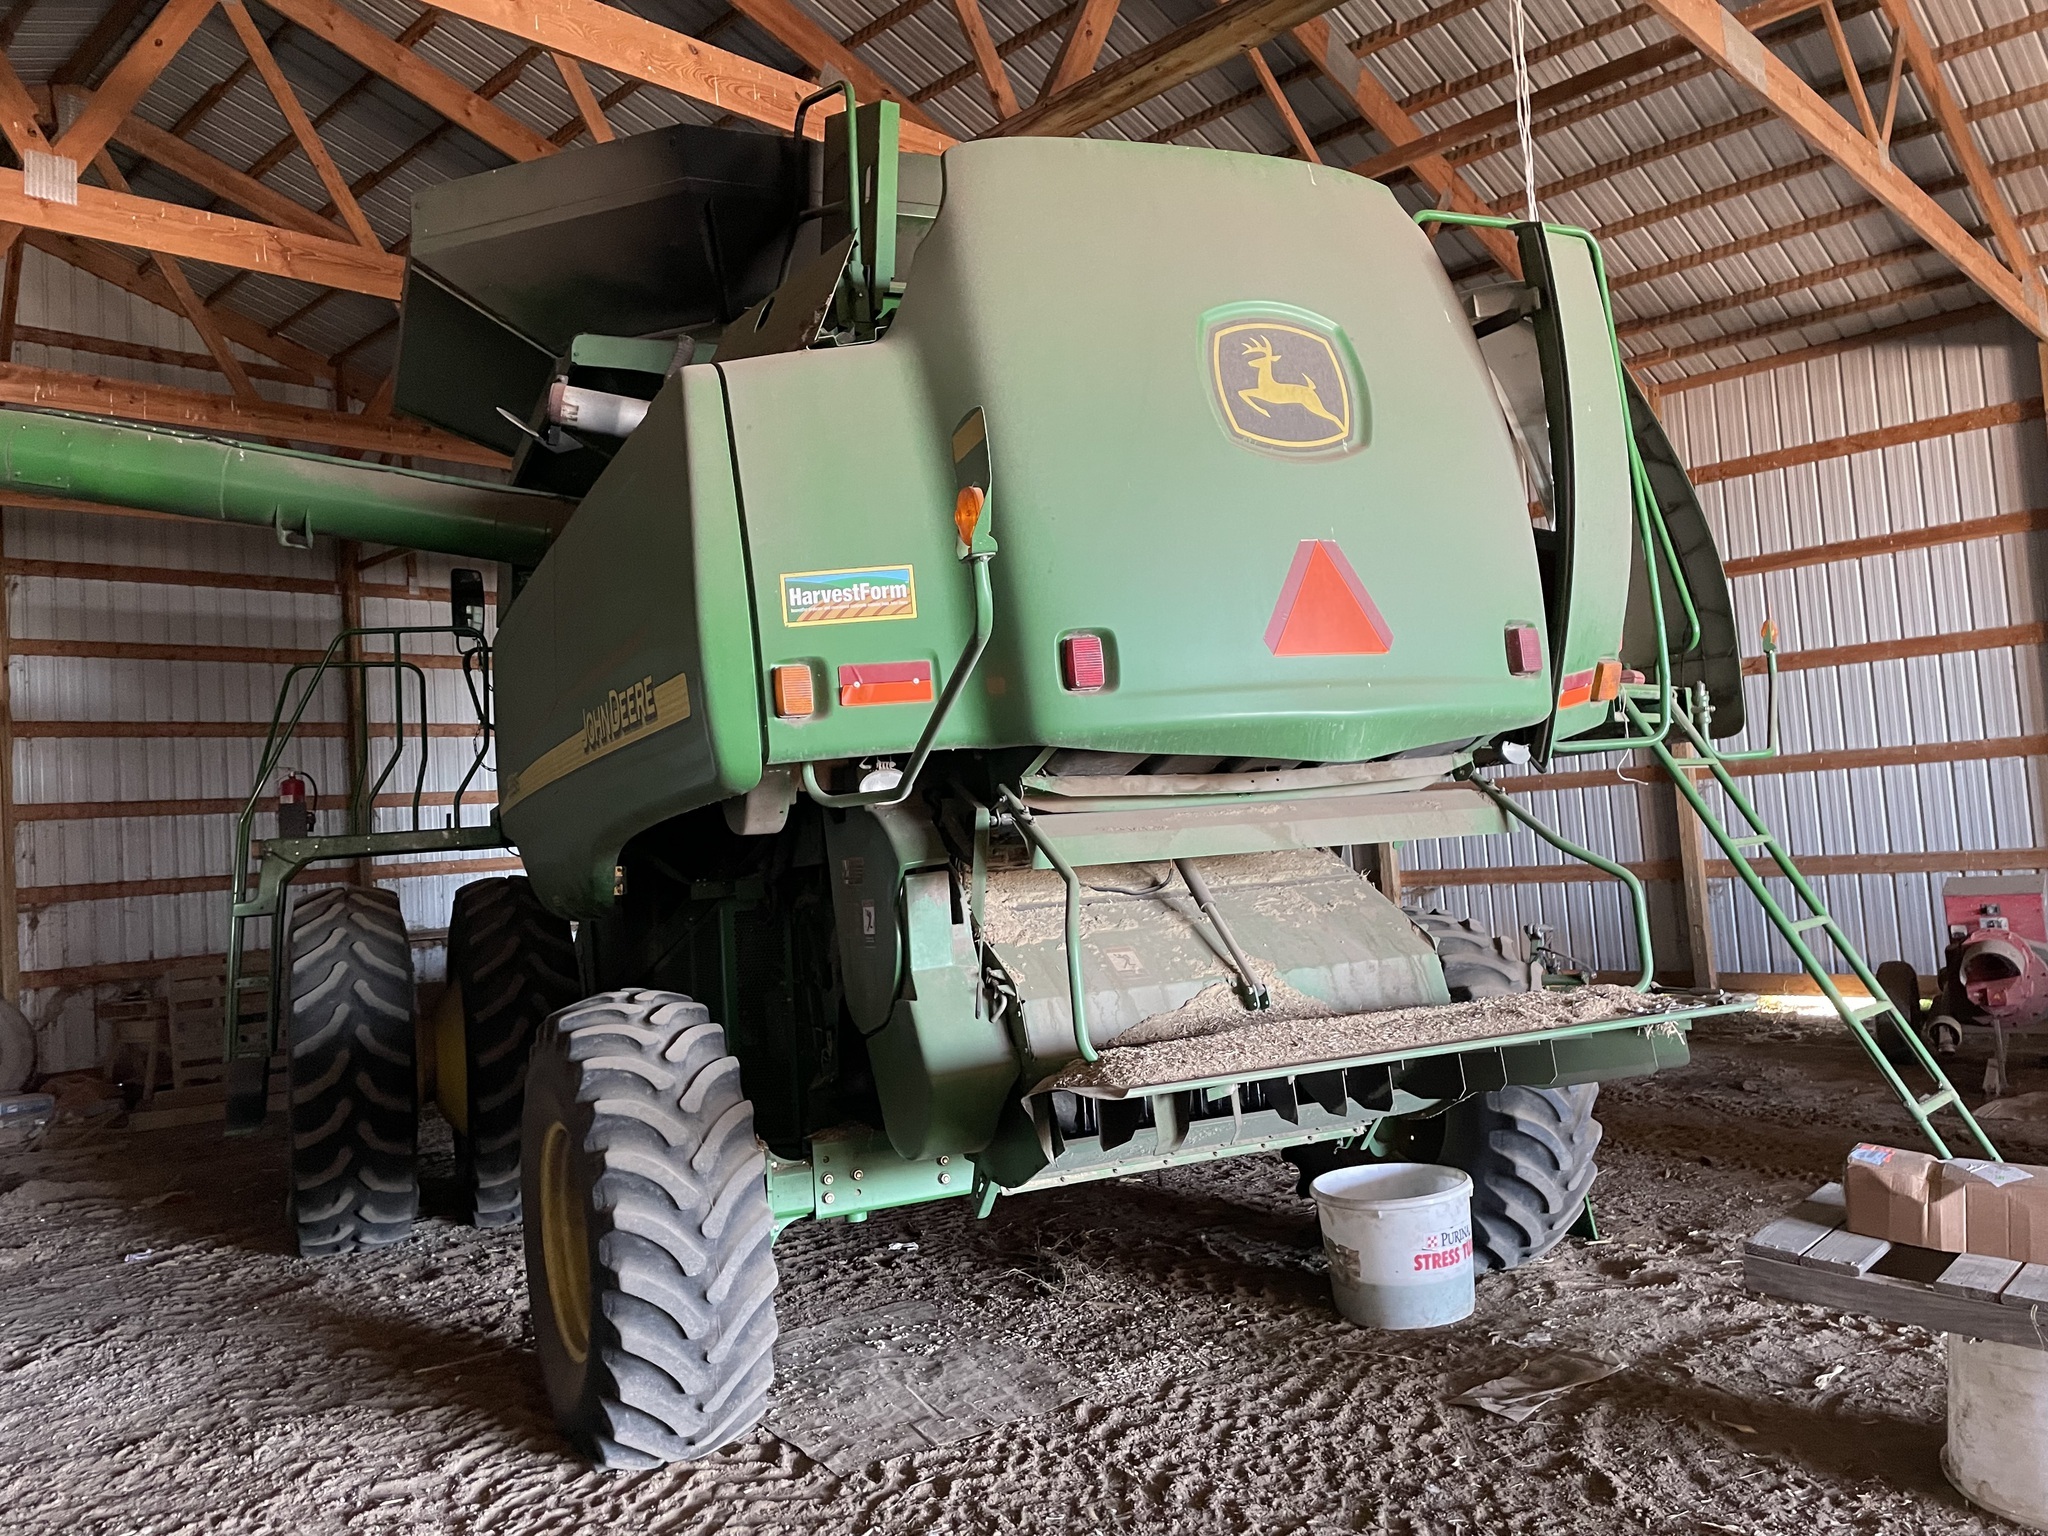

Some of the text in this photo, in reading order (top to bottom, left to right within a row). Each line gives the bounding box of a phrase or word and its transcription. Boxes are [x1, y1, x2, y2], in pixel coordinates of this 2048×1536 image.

[789, 583, 907, 606] HarvestForm
[582, 675, 656, 750] JOHN DEERE
[1414, 1238, 1474, 1271] STRESS TU
